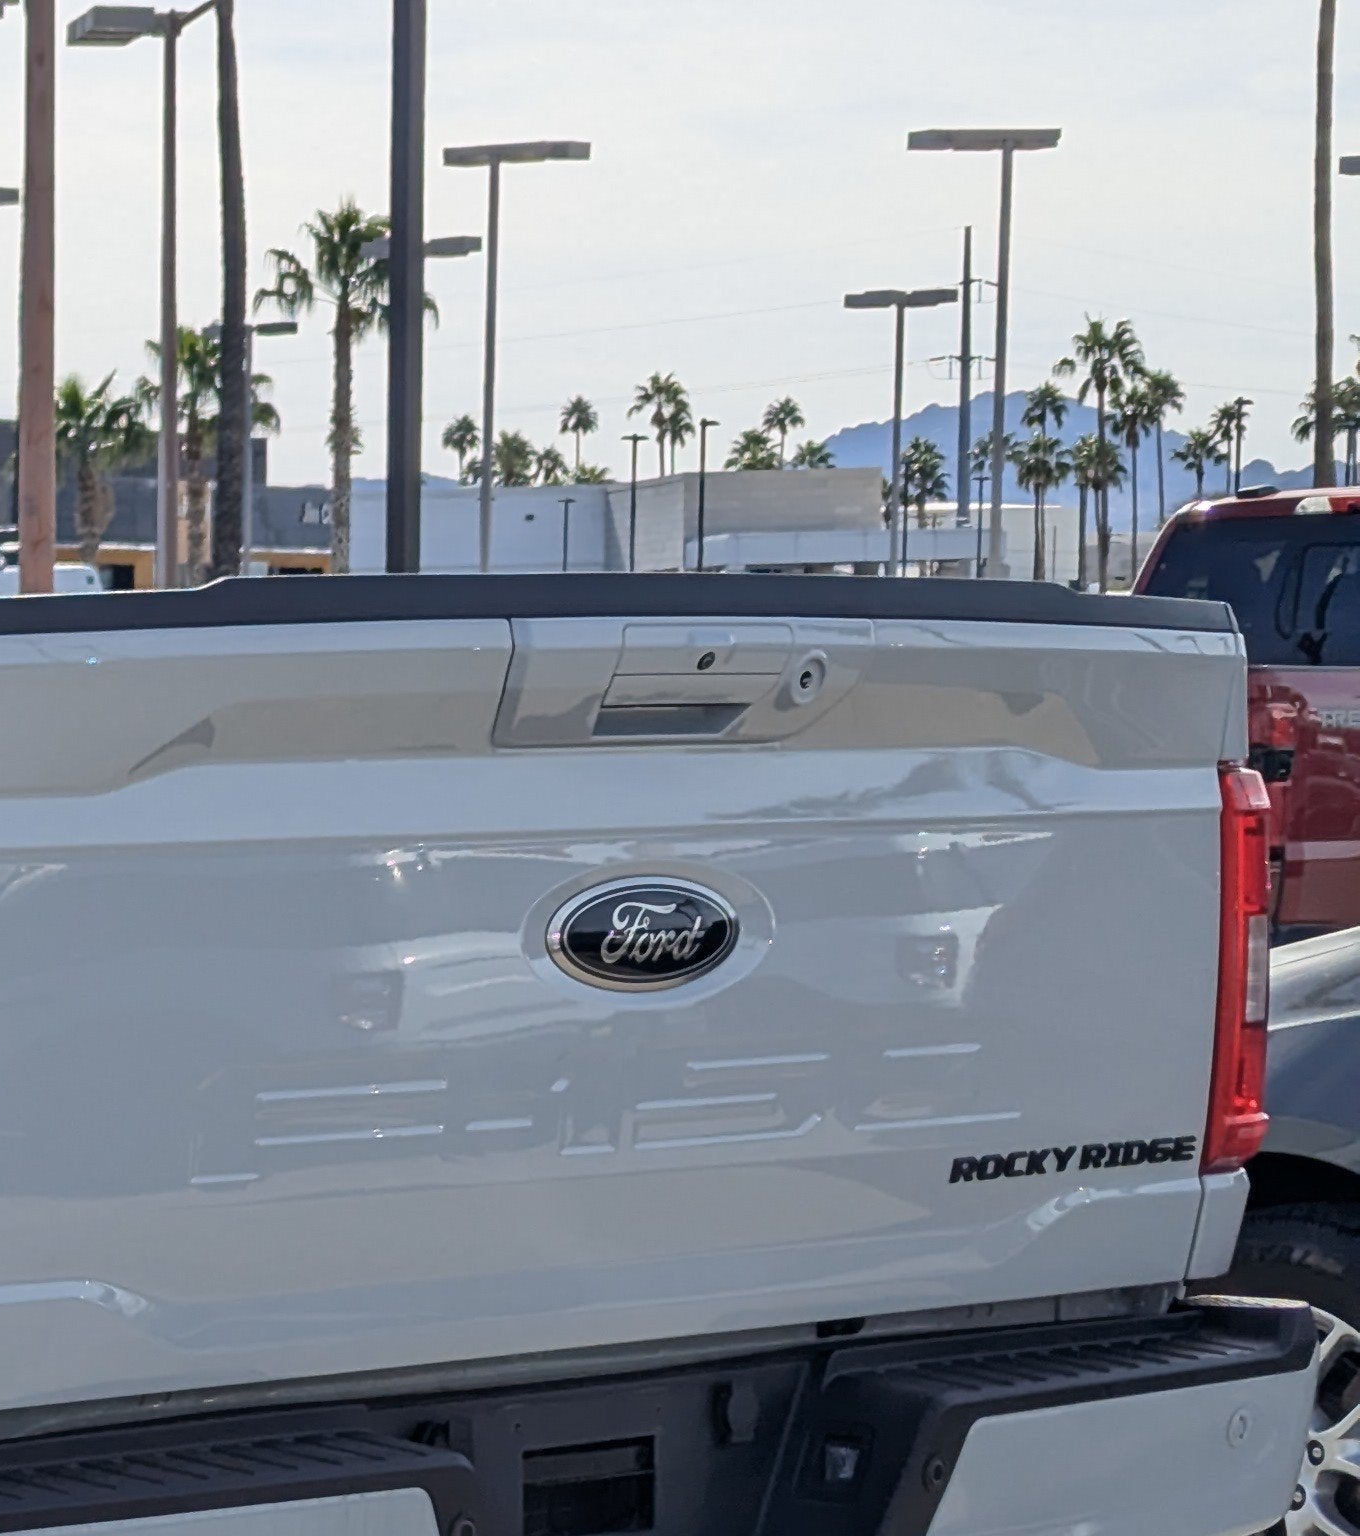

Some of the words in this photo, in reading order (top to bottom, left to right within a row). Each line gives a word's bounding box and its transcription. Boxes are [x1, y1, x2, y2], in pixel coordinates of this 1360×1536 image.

[600, 901, 705, 963] Ford
[948, 1146, 1077, 1184] ROCKY
[1078, 1135, 1197, 1171] RIDGE
